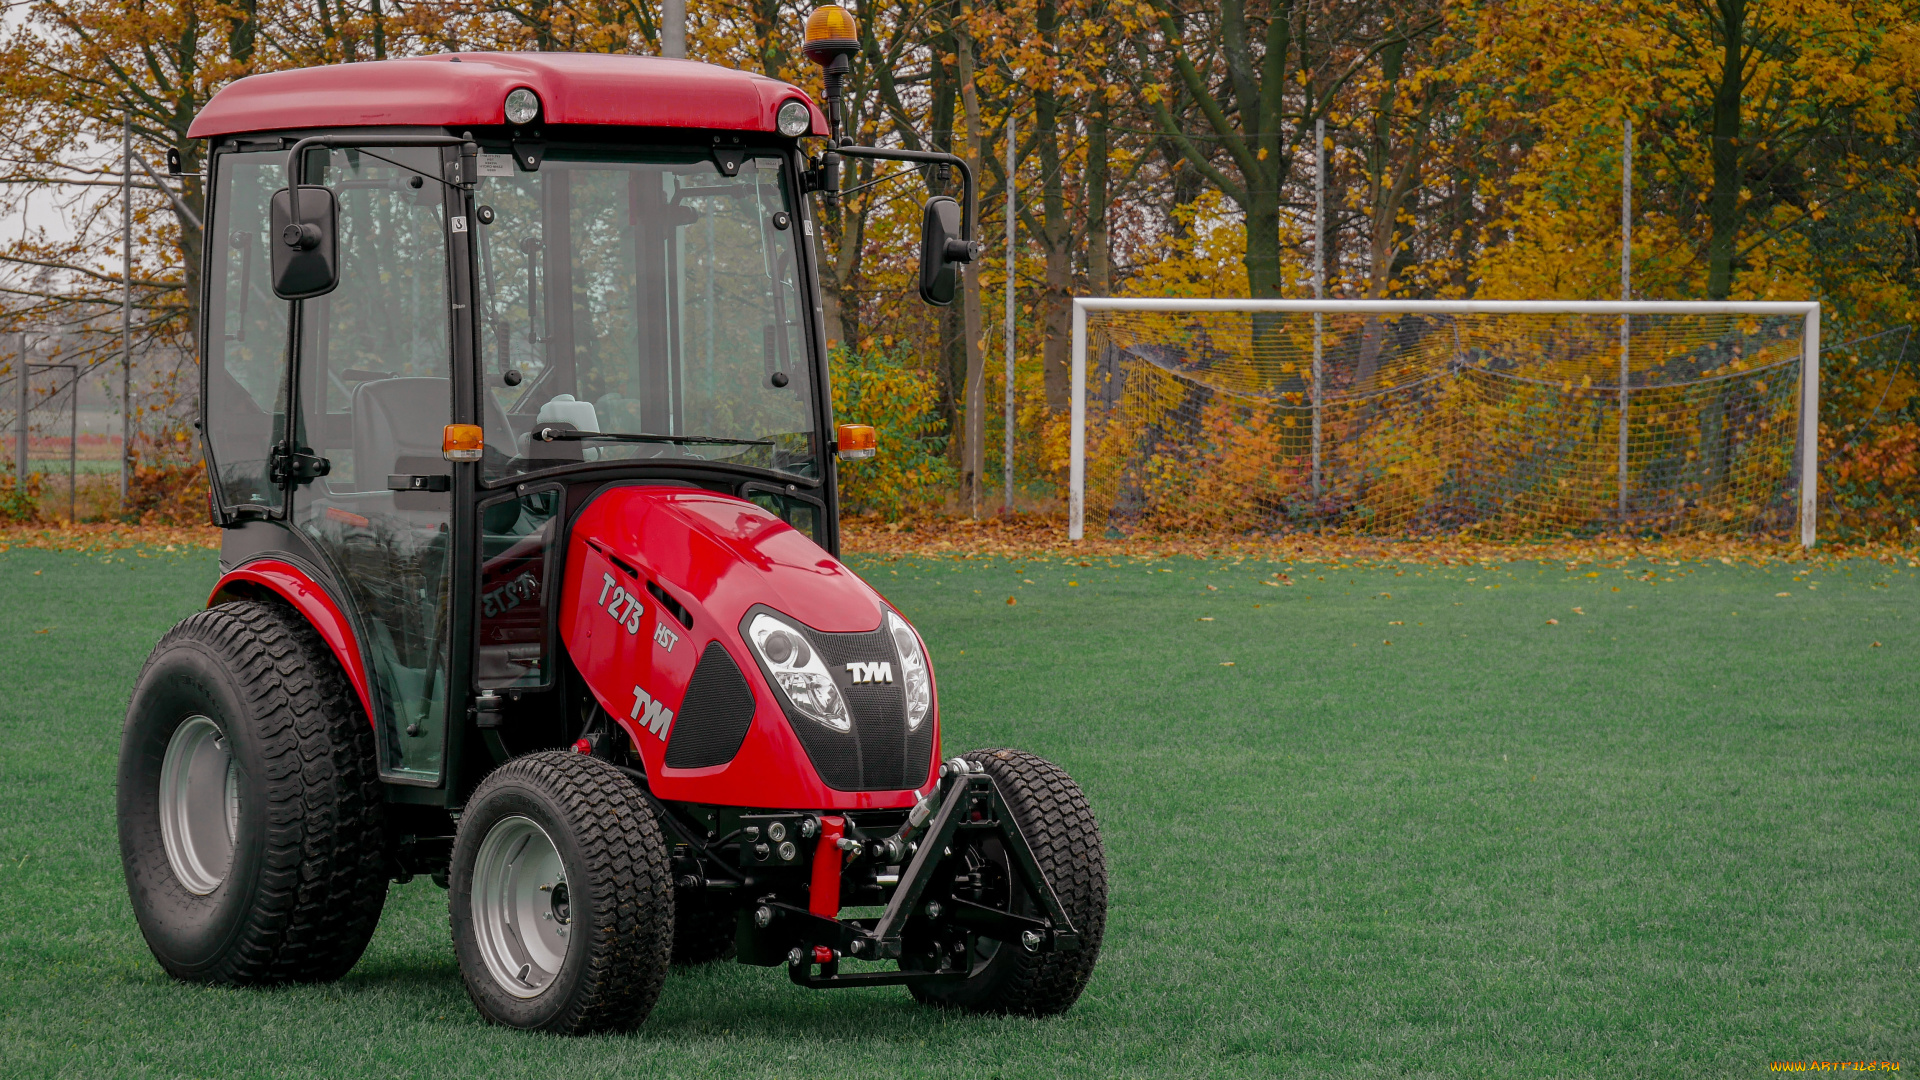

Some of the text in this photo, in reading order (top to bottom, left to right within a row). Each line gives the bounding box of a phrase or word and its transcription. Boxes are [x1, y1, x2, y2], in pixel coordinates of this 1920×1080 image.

[654, 622, 679, 653] HST
[846, 662, 893, 684] TYM
[629, 685, 674, 741] TYM
